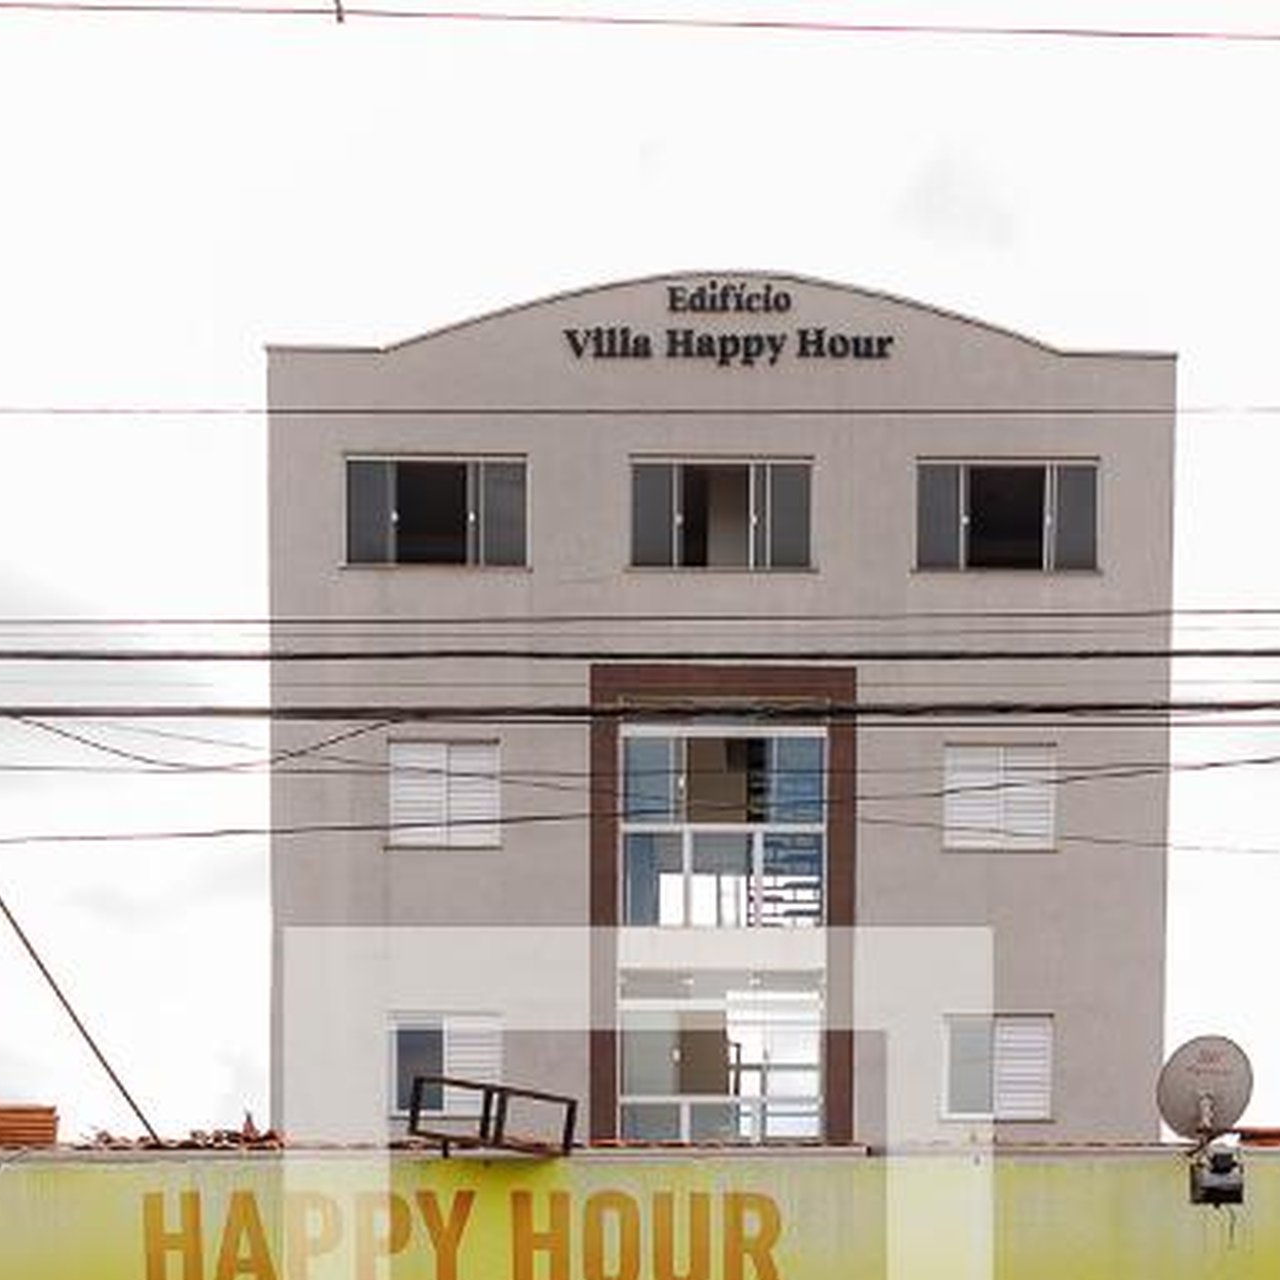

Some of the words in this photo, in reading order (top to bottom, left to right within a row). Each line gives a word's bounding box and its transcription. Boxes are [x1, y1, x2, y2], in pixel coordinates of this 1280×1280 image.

[666, 280, 792, 313] Edifício
[564, 328, 653, 359] Villa
[665, 328, 787, 367] Happy
[796, 328, 895, 359] Hour
